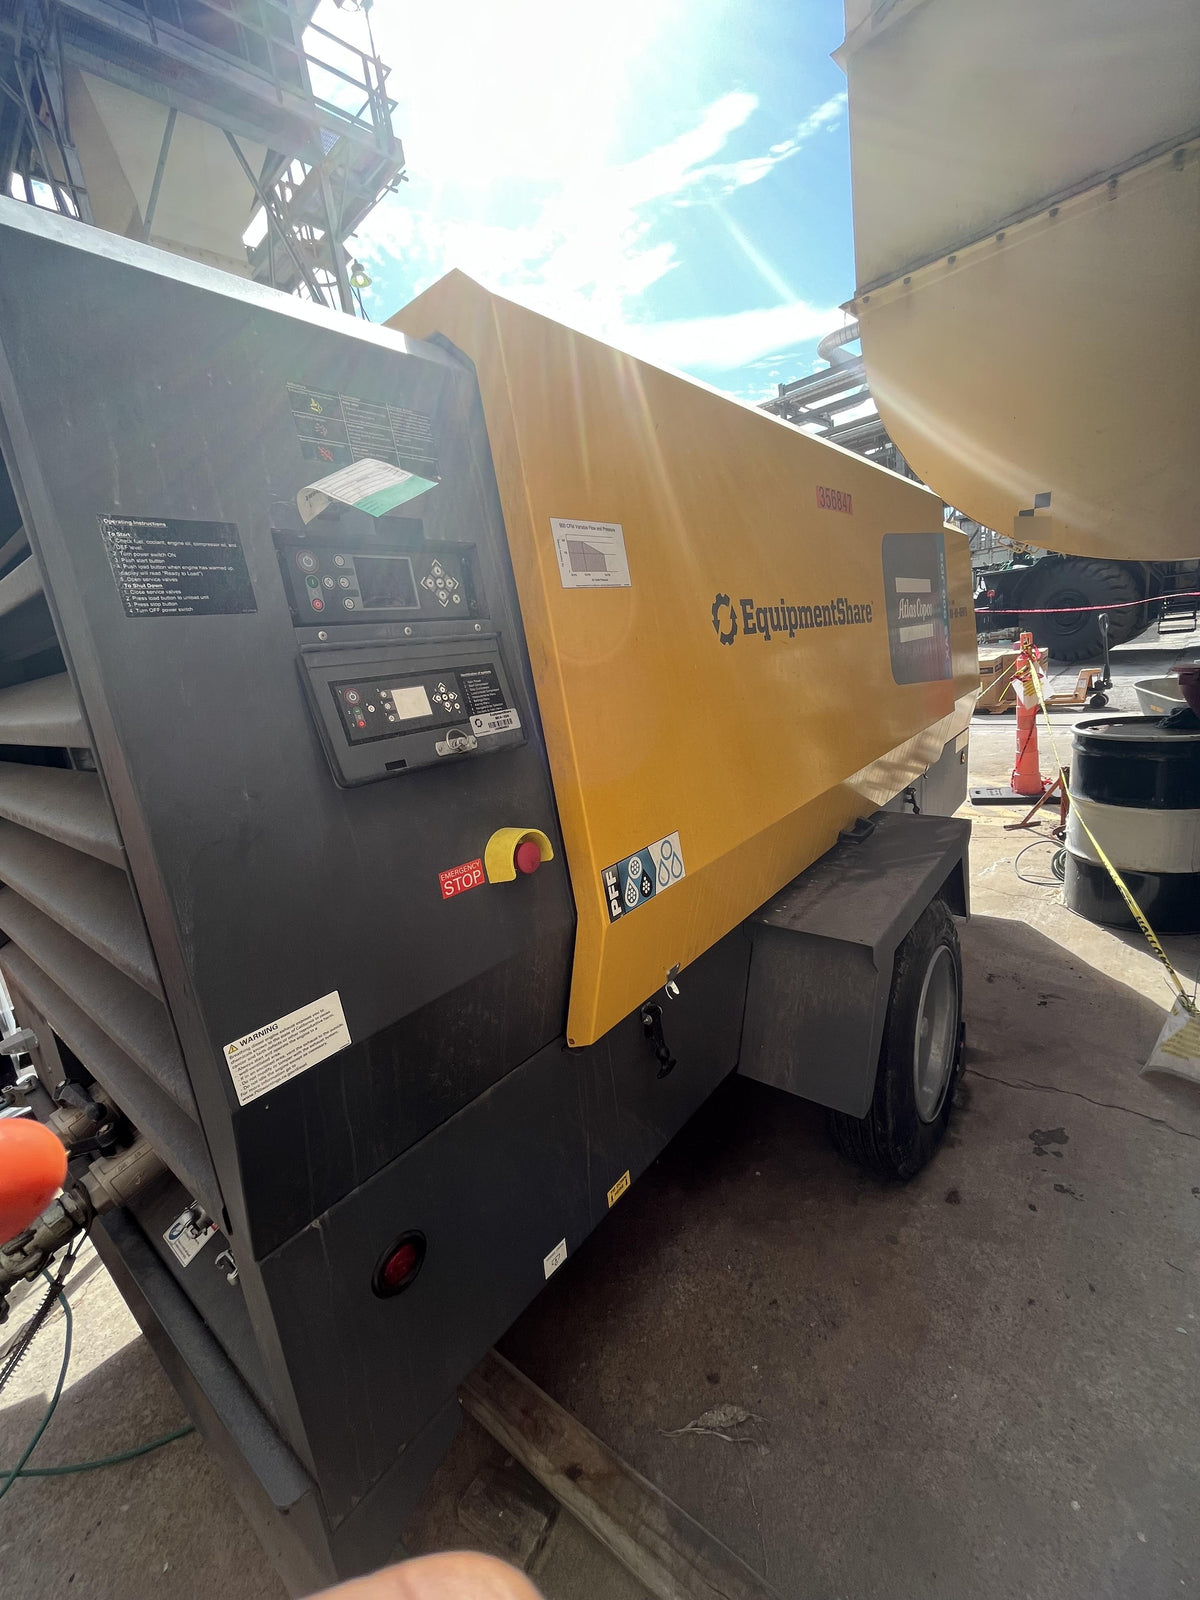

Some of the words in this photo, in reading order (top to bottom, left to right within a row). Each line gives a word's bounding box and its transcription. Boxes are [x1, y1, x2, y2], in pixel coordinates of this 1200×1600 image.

[818, 486, 852, 512] 356847
[740, 598, 872, 641] EquipmentShare
[898, 598, 916, 620] Atlas
[916, 598, 932, 621] Copco
[440, 862, 480, 881] EMERGENCY
[444, 870, 481, 896] STOP
[606, 871, 622, 916] PFF
[230, 1051, 252, 1065] chemicals
[253, 1043, 267, 1053] known
[296, 1019, 314, 1030] California
[239, 1023, 278, 1046] WARNING
[251, 1040, 264, 1048] diesel
[265, 1032, 279, 1042] engine
[296, 1031, 310, 1040] engine
[232, 1059, 246, 1069] cancer
[257, 1067, 272, 1077] modify
[275, 1063, 289, 1072] engine
[248, 1084, 260, 1092] more
[261, 1070, 285, 1086] information
